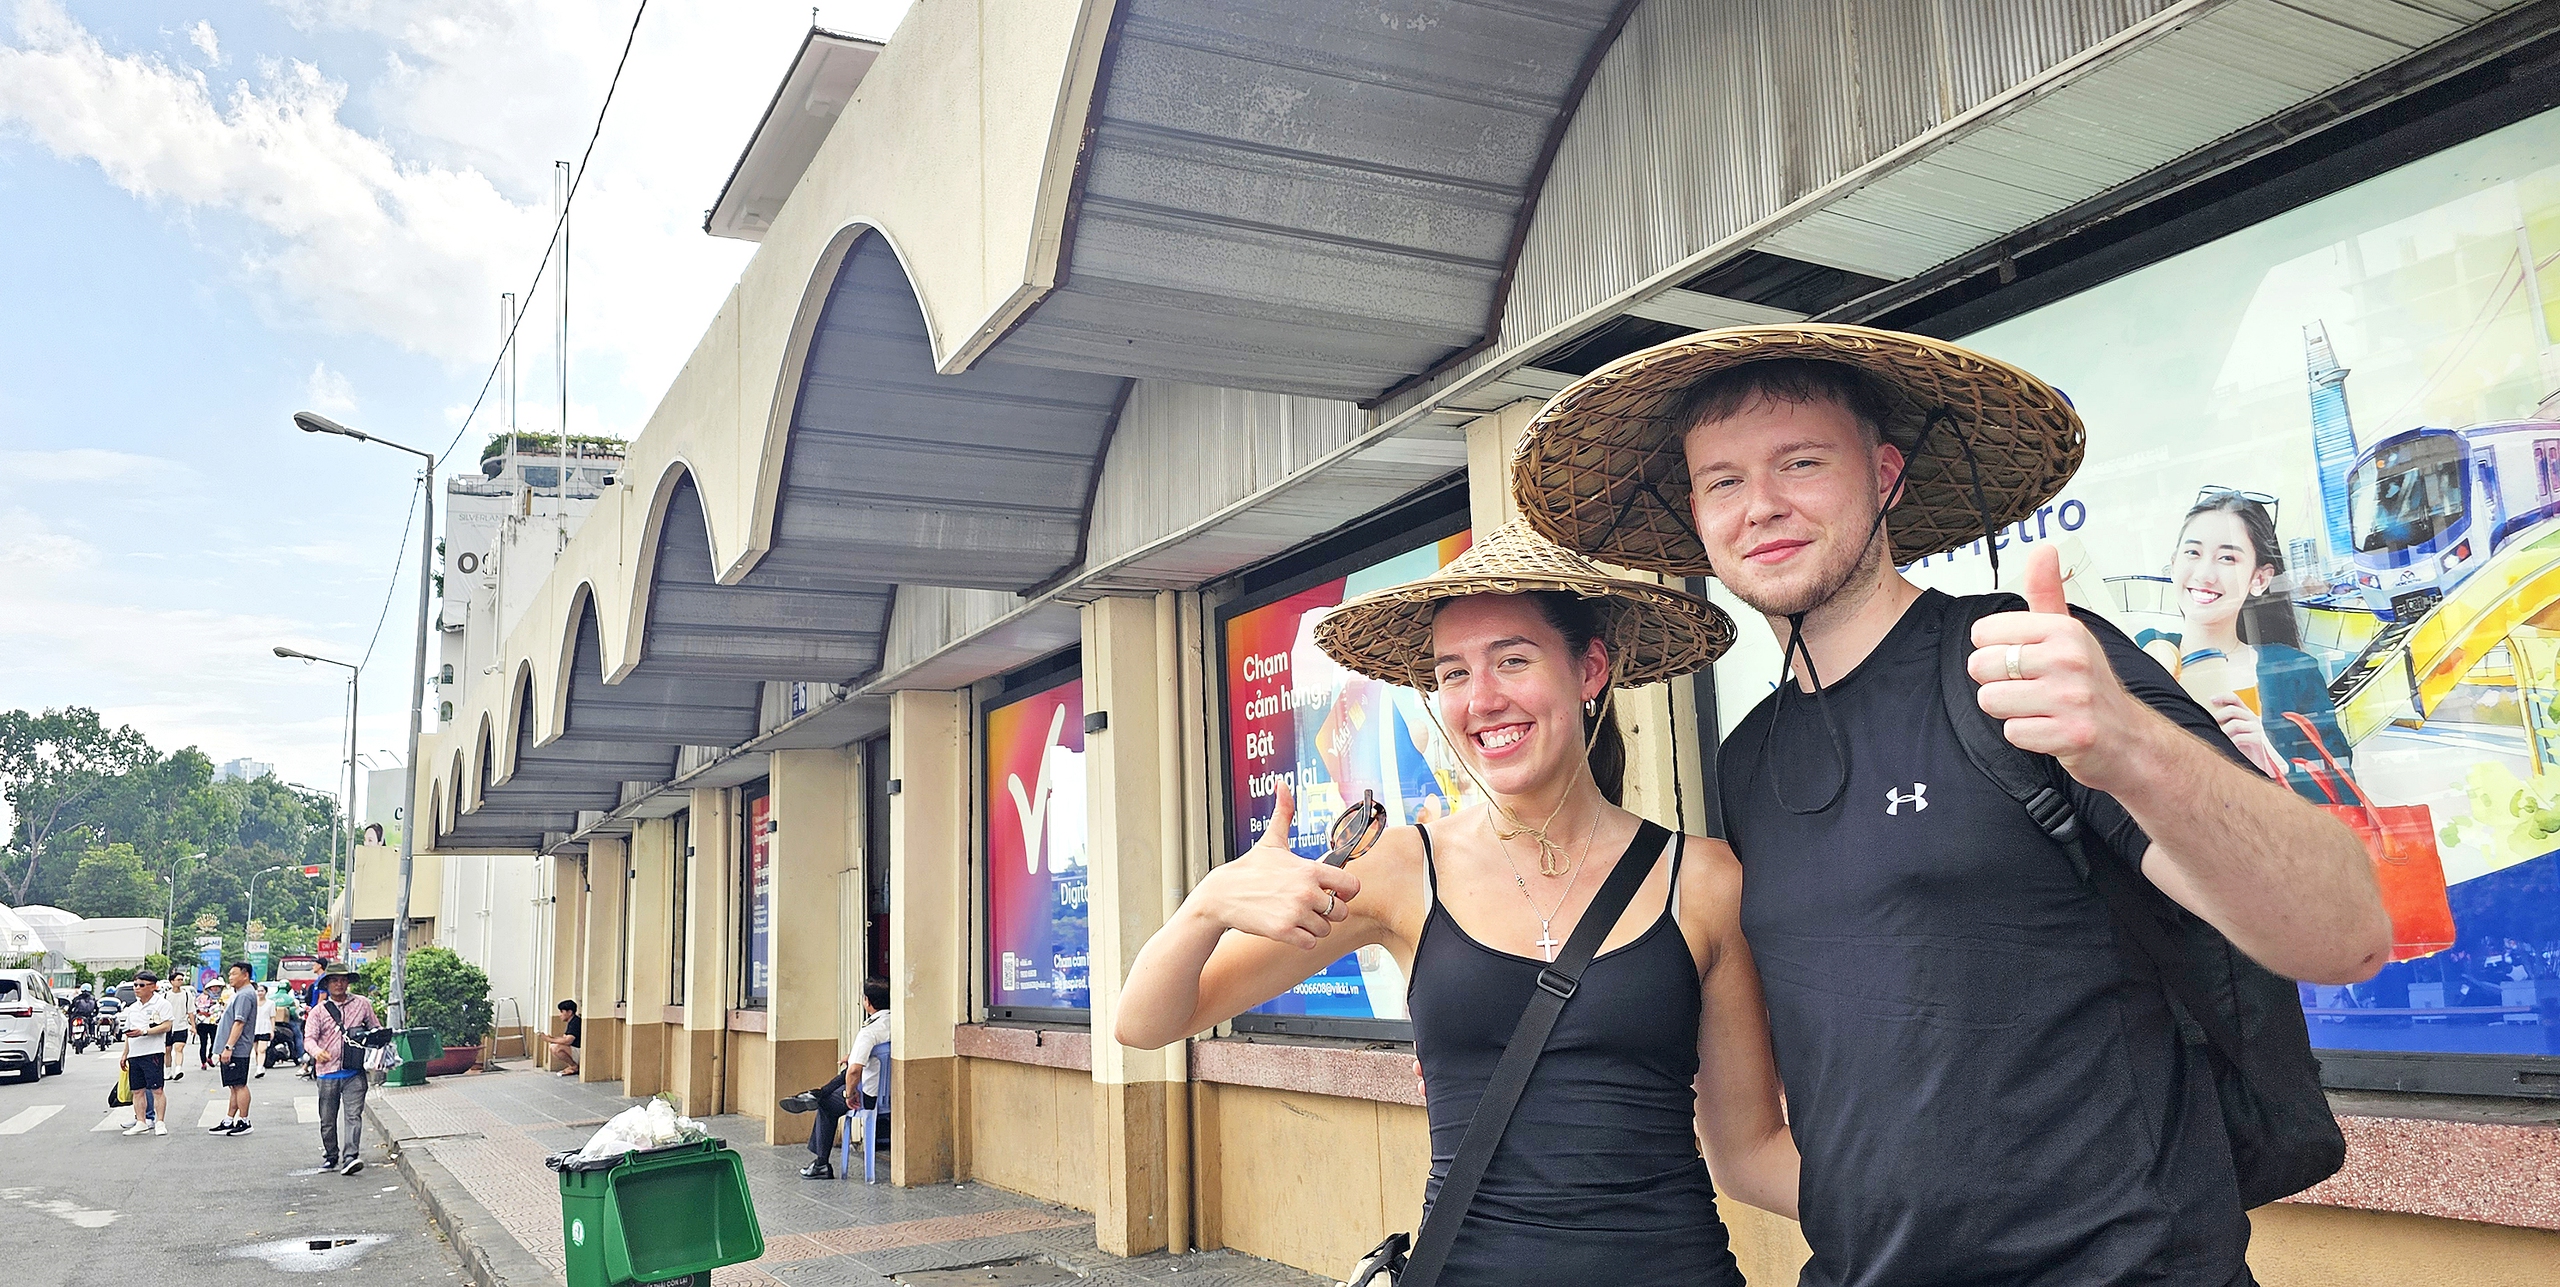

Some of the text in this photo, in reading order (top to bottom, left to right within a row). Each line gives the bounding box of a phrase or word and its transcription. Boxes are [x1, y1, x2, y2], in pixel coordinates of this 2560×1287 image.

[459, 513, 500, 521] SILVERLAN
[1243, 651, 1288, 684] Chạm
[1245, 689, 1279, 721] cảm
[1246, 729, 1275, 765] Bật
[1250, 817, 1263, 833] Be
